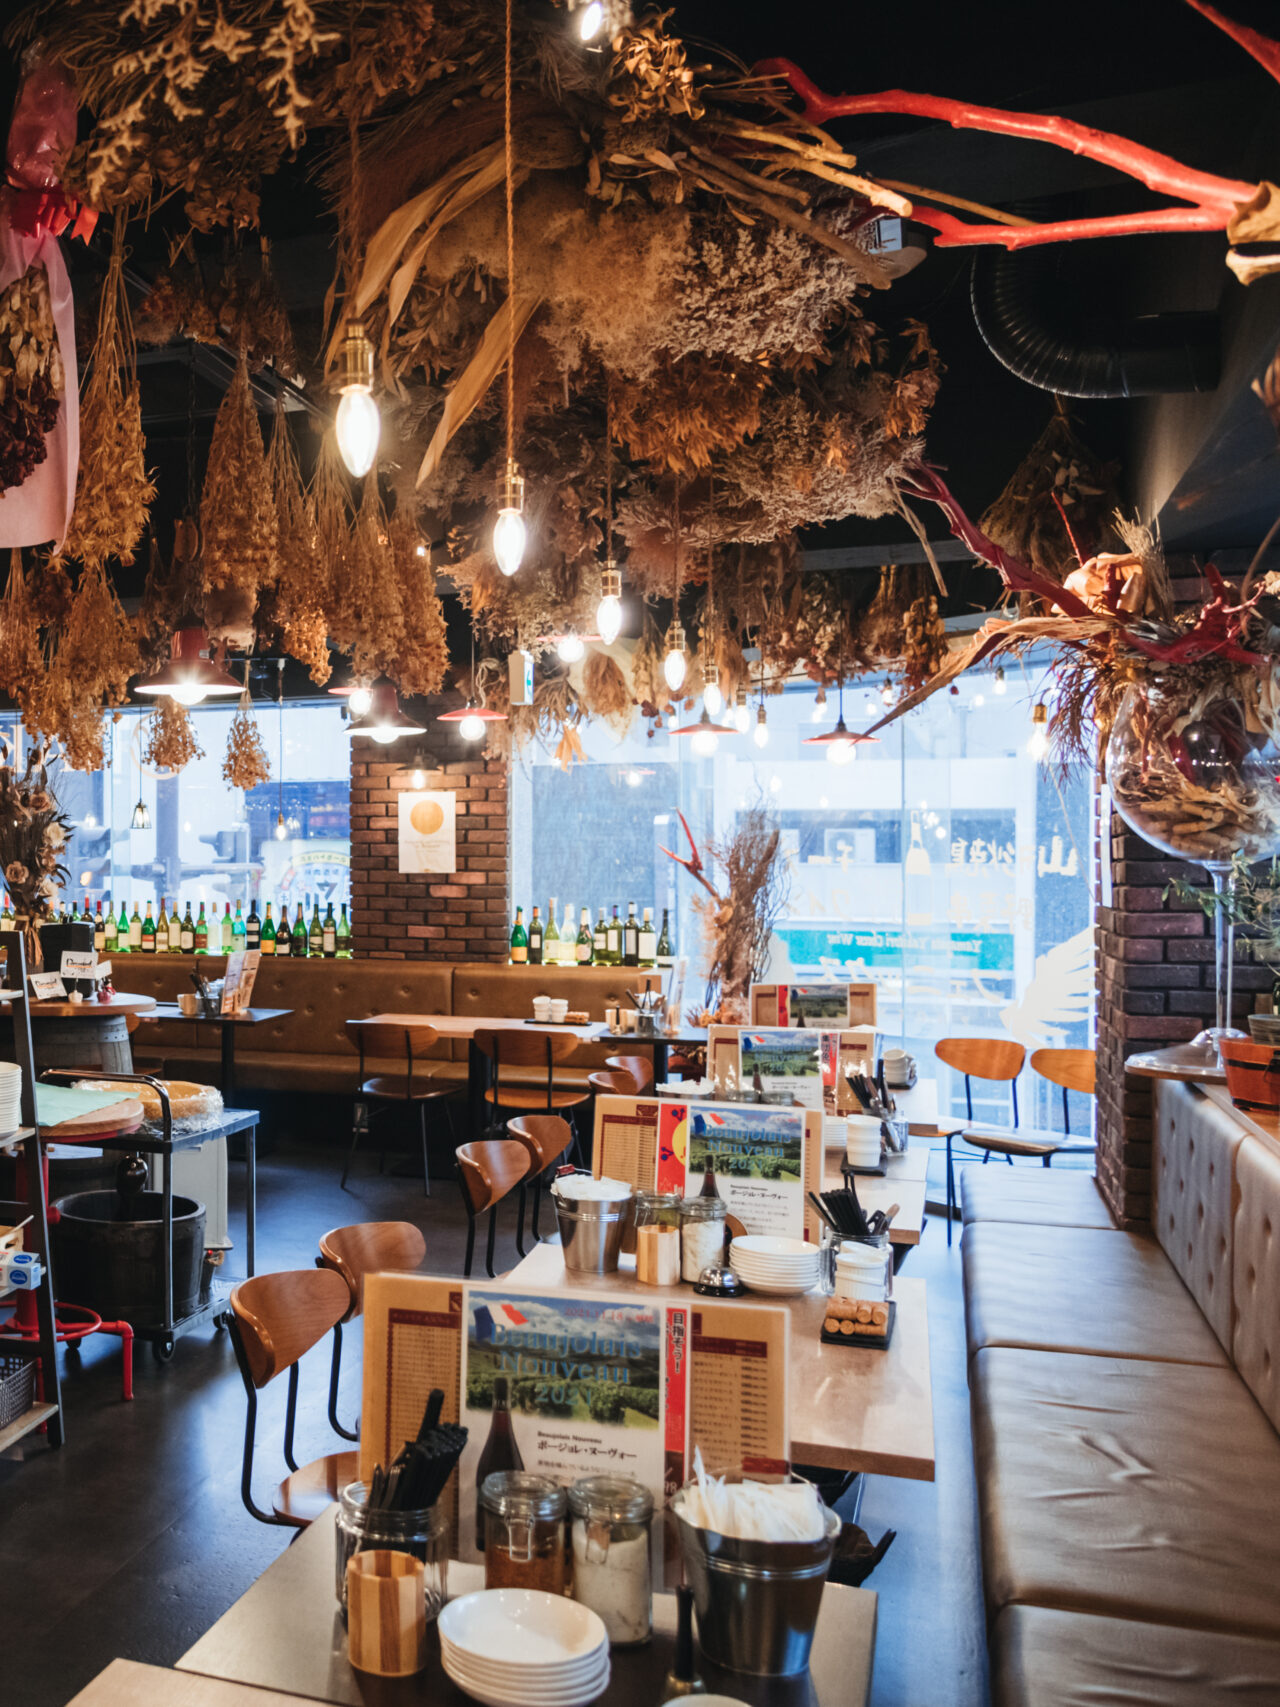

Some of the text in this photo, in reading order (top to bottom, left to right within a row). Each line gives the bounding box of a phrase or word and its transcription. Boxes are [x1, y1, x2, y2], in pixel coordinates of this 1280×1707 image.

[704, 1123, 792, 1144] Beaujolais
[708, 1140, 784, 1158] Nouveau
[491, 1323, 642, 1359] Beaujolais
[500, 1351, 631, 1385] Nouveau
[535, 1383, 592, 1407] 2021
